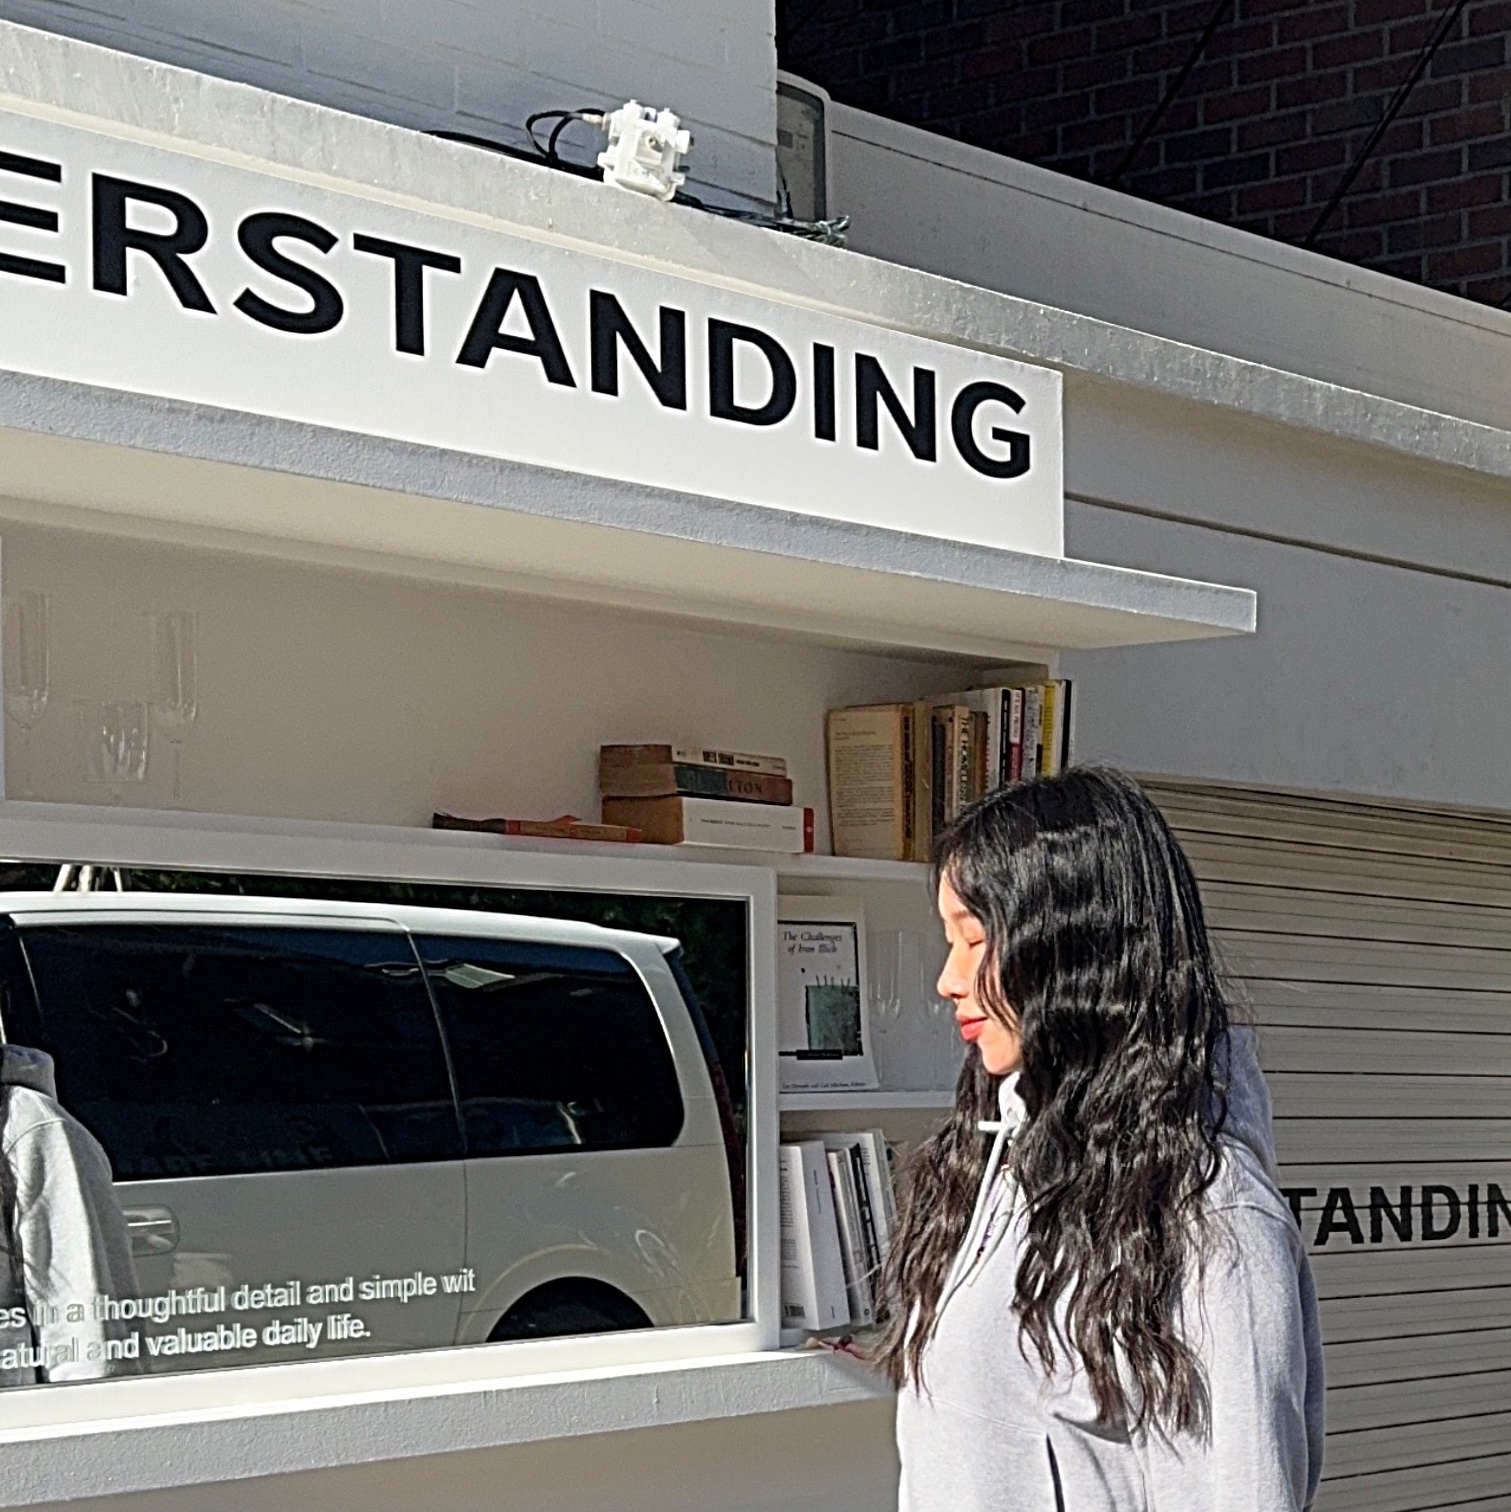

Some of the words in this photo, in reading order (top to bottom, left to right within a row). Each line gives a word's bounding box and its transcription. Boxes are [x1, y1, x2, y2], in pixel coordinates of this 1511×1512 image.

[66, 1303, 84, 1322] a
[92, 1285, 225, 1323] thoughtful
[231, 1281, 301, 1311] detail
[306, 1277, 353, 1305] and
[358, 1271, 437, 1303] simple
[86, 1331, 140, 1361] and
[144, 1322, 258, 1357] valuable
[262, 1317, 323, 1349] daily
[327, 1313, 371, 1340] life.
